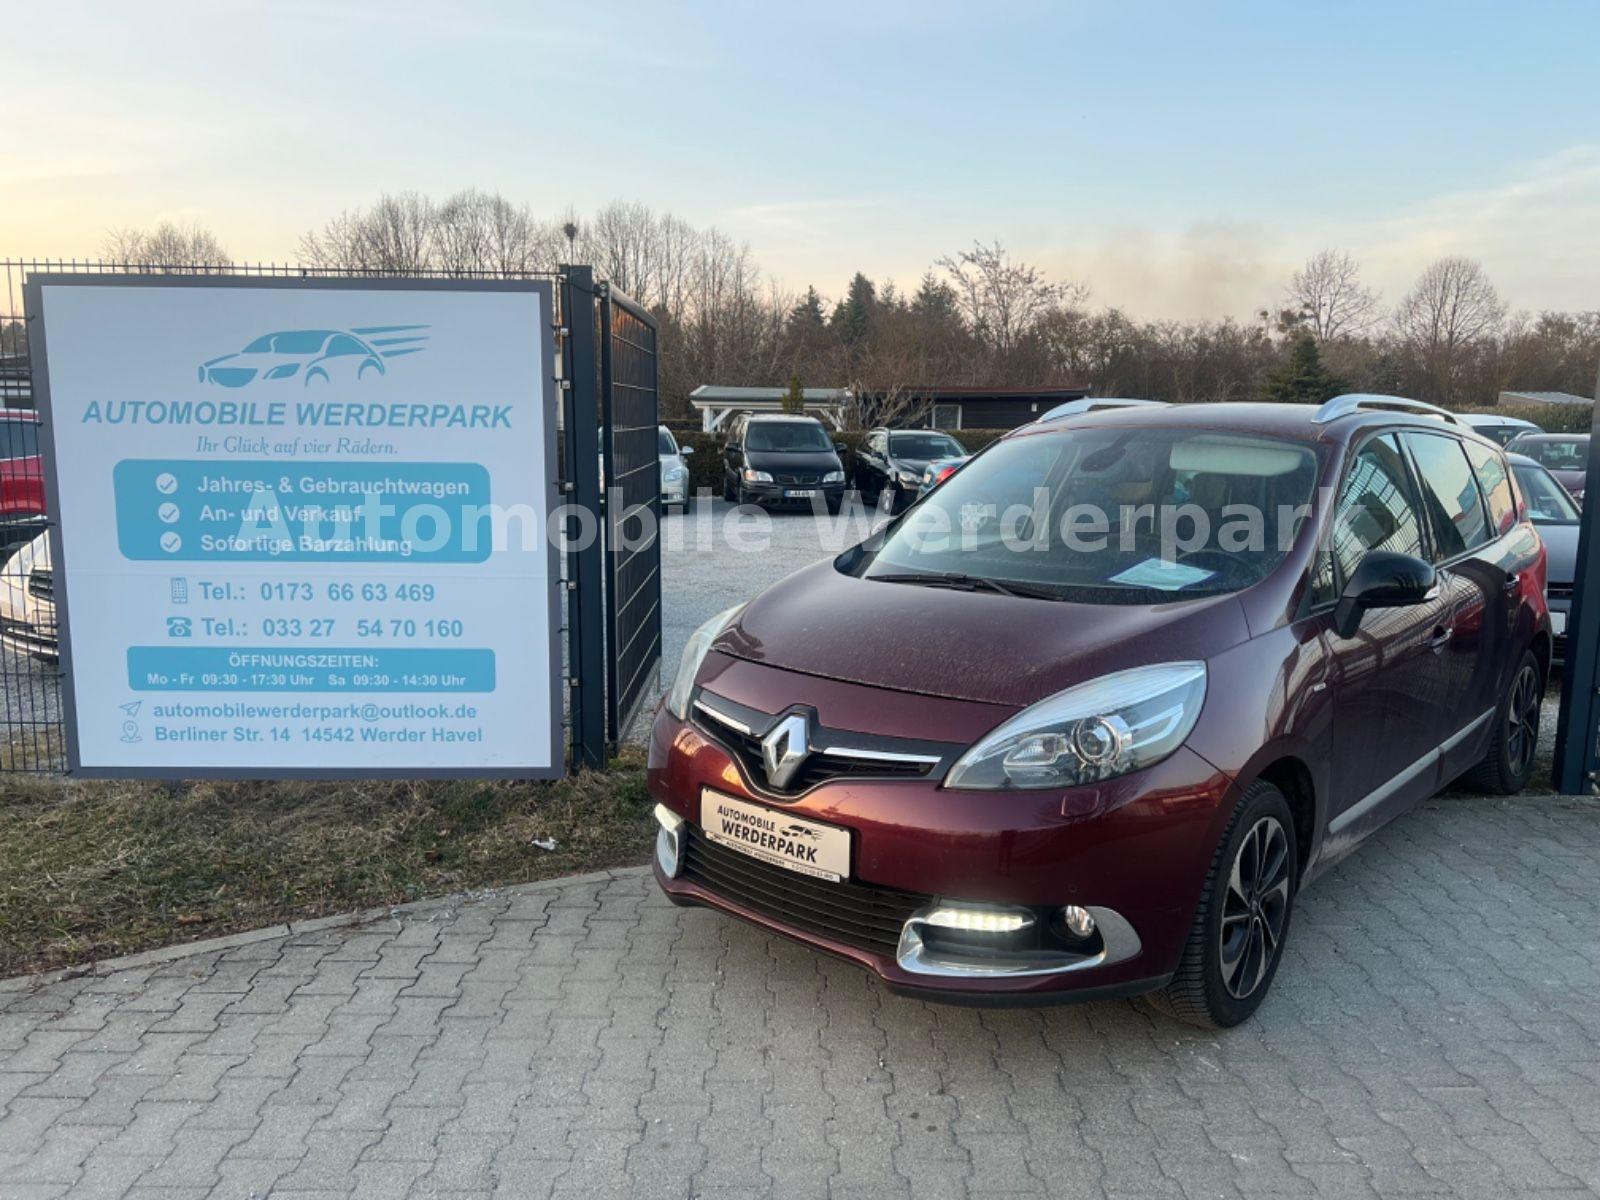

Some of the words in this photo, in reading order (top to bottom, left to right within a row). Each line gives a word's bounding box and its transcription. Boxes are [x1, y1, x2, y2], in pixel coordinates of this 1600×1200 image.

[82, 400, 286, 425] AUTOMOBILE
[296, 402, 513, 428] WERDERPARK
[196, 436, 219, 453] Ihr
[224, 436, 269, 456] Glück
[274, 436, 300, 456] auf
[304, 439, 332, 454] vier
[336, 437, 399, 455] Rädern.
[198, 476, 273, 493] Jahres-
[278, 476, 293, 493] &
[300, 476, 470, 498] Gebrauchtwagen
[200, 505, 235, 521] An-
[241, 506, 279, 522] und
[284, 505, 362, 523] Verkauf
[201, 534, 293, 555] Sofortige
[300, 535, 413, 556] Barzahlung
[198, 582, 246, 600] Tel.:
[260, 582, 314, 601] 0173
[328, 583, 354, 601] 66
[361, 583, 388, 601] 63
[395, 583, 435, 602] 469
[201, 618, 248, 637] Tel.:
[262, 618, 302, 637] 033
[309, 619, 336, 637] 27
[357, 619, 383, 637] 54
[390, 619, 416, 637] 70
[425, 620, 463, 638] 160
[229, 651, 379, 668] ÖFFNUNGSZEITEN:
[147, 673, 168, 685] Mo
[180, 674, 194, 685] Fr
[202, 673, 238, 686] 09:30
[251, 674, 286, 686] 17:30
[290, 674, 315, 686] Uhr
[328, 674, 346, 686] Sa
[353, 674, 389, 687] 09:30
[402, 674, 438, 687] 14:30
[441, 675, 466, 687] Uhr
[153, 702, 477, 722] automobilewerderpark@outlook.de
[155, 726, 230, 742] Berliner
[233, 727, 264, 742] Str.
[269, 727, 291, 742] 14
[302, 727, 355, 742] 14542
[360, 728, 426, 743] Werder
[431, 728, 482, 743] Havel
[717, 805, 775, 832] AUTOMOBILE
[722, 819, 818, 863] WERDERPARK
